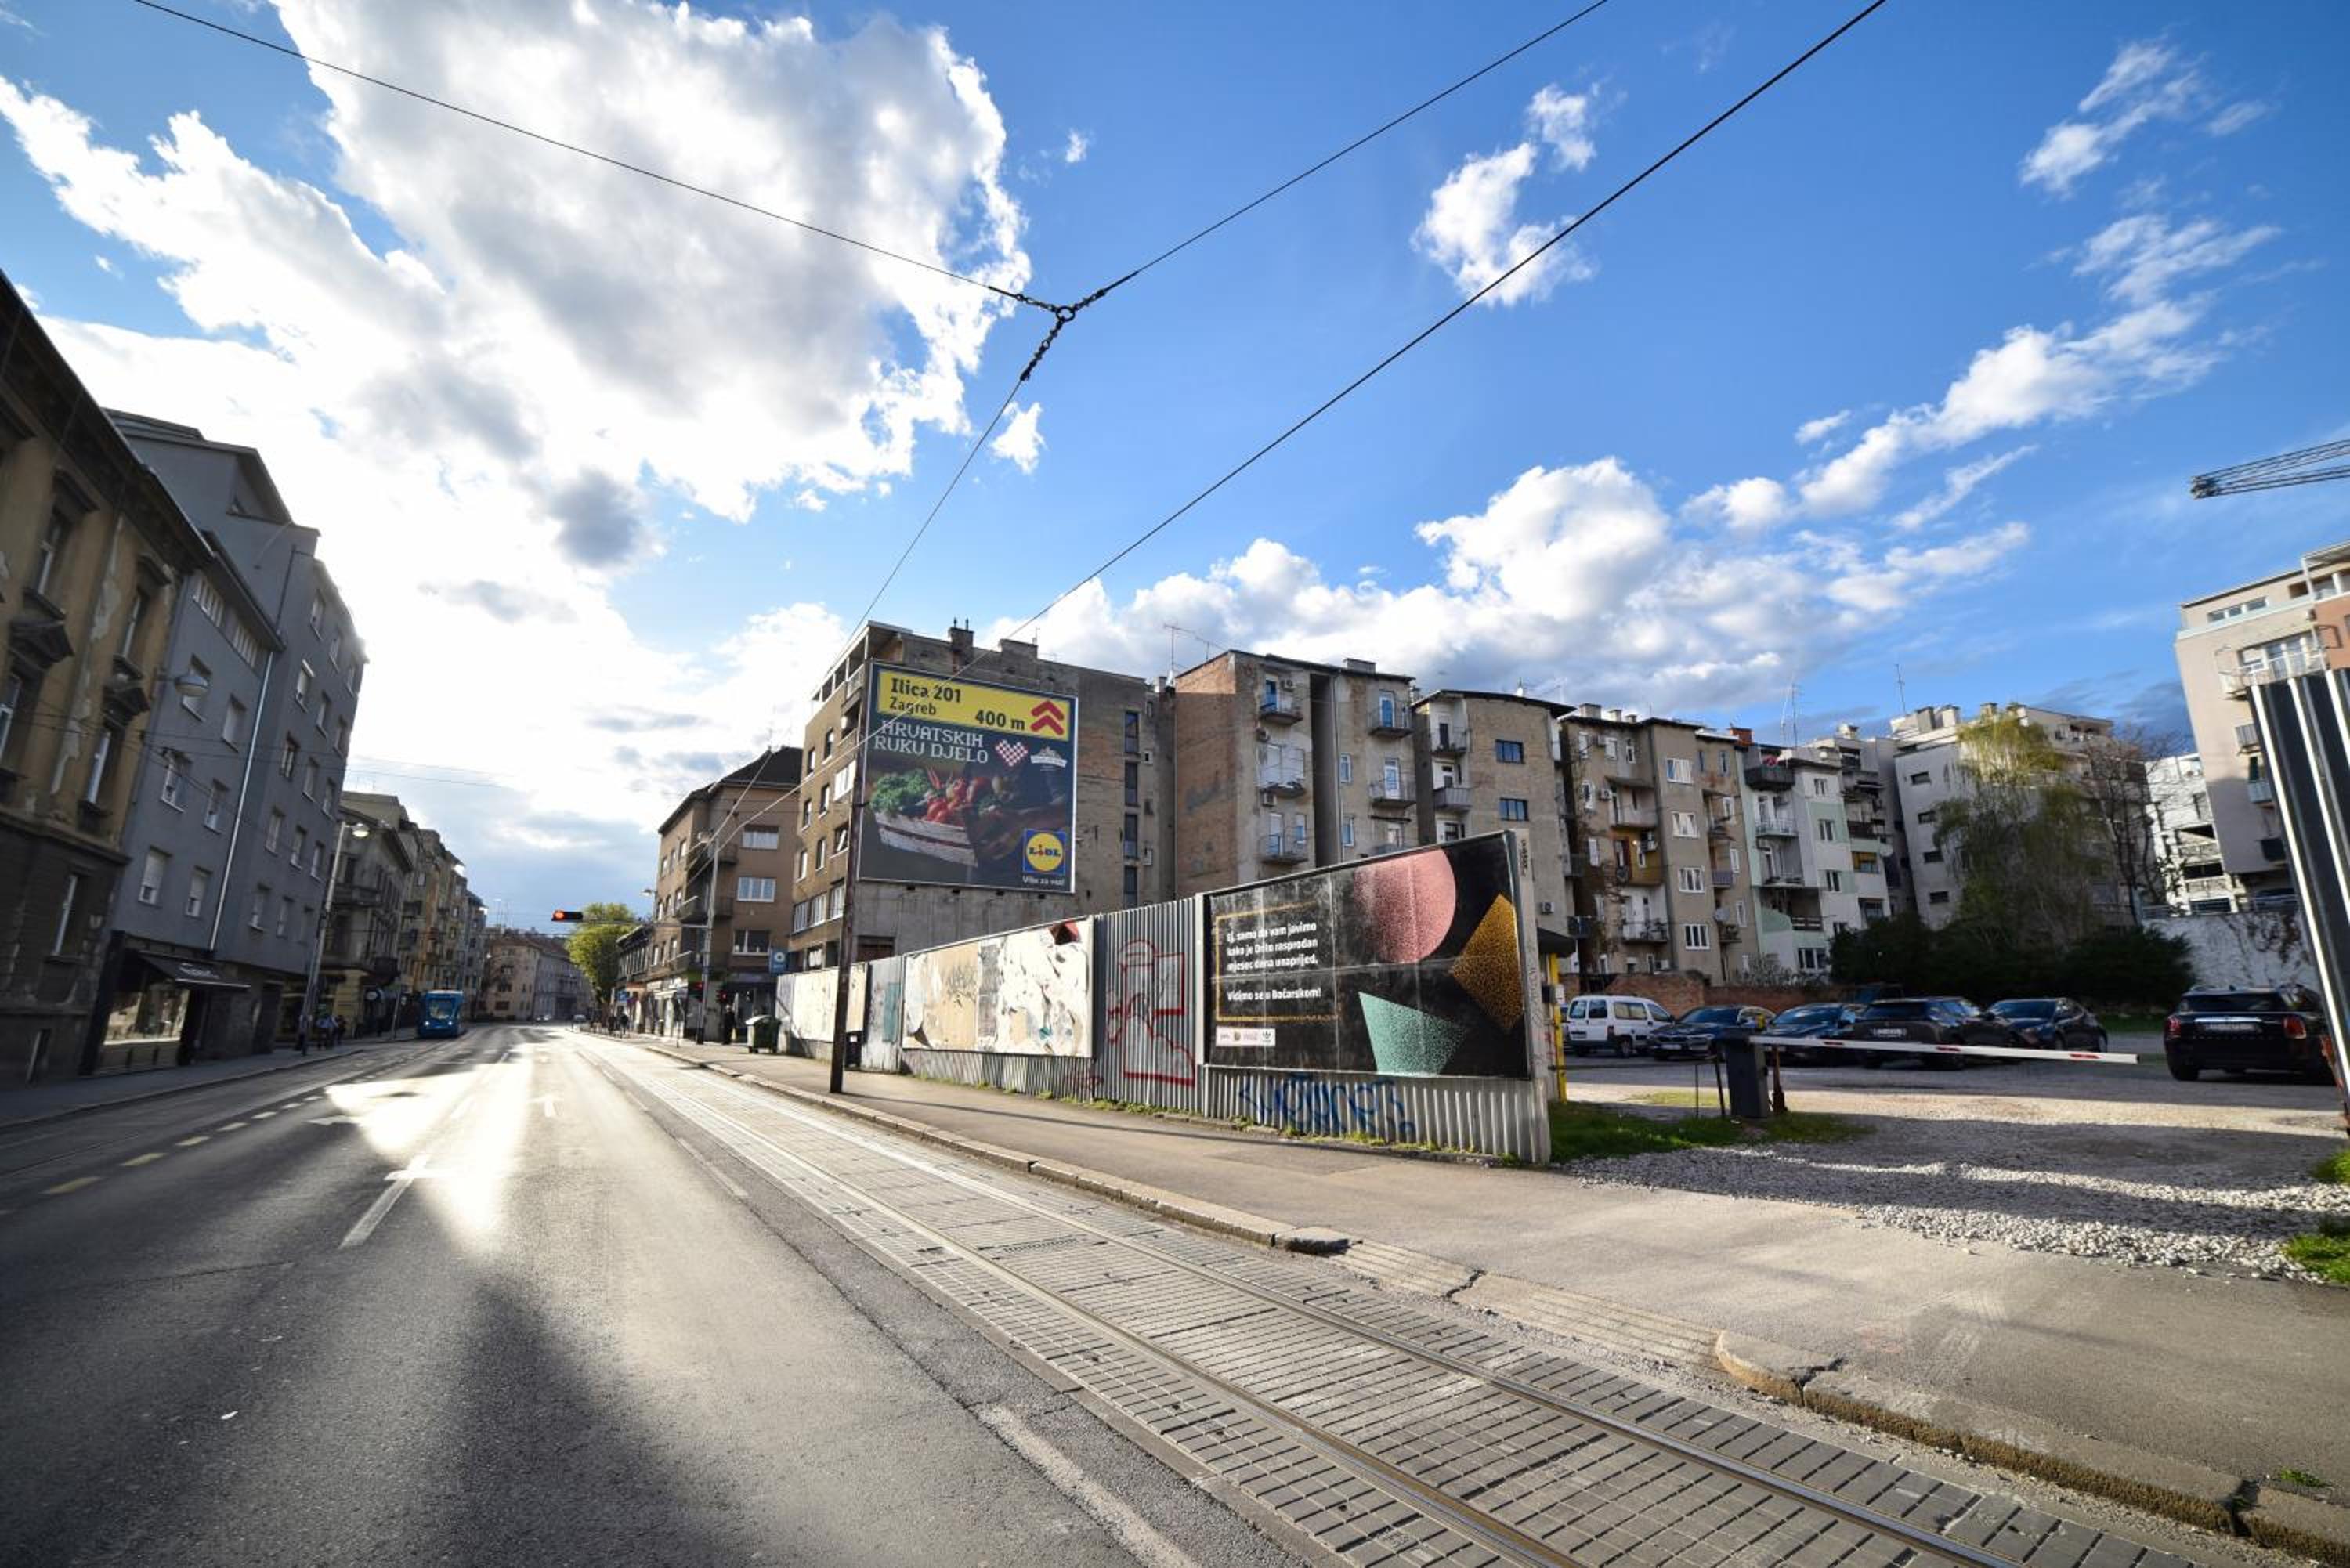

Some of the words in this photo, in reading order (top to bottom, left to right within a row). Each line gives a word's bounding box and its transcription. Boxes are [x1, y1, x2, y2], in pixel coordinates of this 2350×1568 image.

[891, 677, 929, 698] Ilica
[933, 684, 961, 703] 201
[889, 696, 937, 716] Zagreb
[975, 710, 1007, 728] 400
[1011, 718, 1025, 731] m
[880, 720, 985, 748] HRVATSKIH
[874, 735, 925, 755] RUKU
[931, 742, 989, 764] DJELO
[1270, 926, 1287, 936] vam
[1287, 920, 1317, 938] javimo
[1246, 943, 1253, 956] je
[1274, 938, 1318, 952] rasprodan
[1227, 989, 1253, 1002] Vidimo
[1254, 990, 1264, 1000] se
